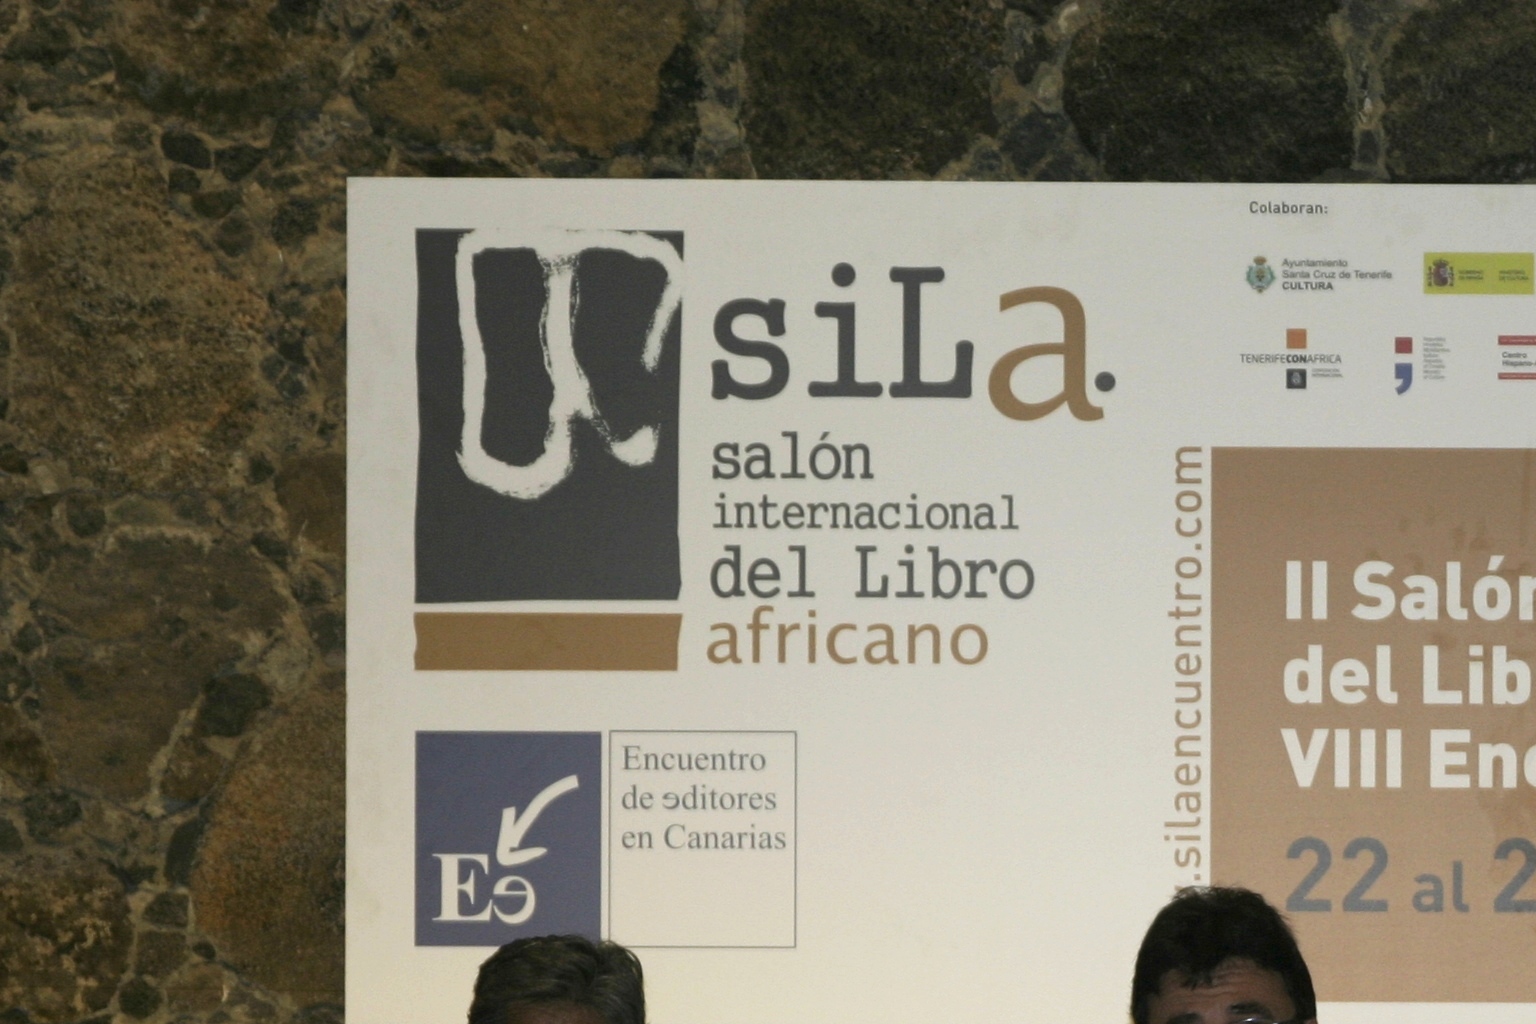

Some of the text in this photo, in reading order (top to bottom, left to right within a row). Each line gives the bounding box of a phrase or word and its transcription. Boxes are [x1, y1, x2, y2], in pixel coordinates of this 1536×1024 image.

[1249, 201, 1328, 215] Colaboran:
[1281, 258, 1348, 268] Ayuntamiento
[1281, 270, 1392, 279] Santa Cruz de Tenerife
[1281, 282, 1334, 290] CULTURA
[711, 432, 874, 480] salón
[712, 493, 1020, 530] internacional
[709, 545, 1036, 600] del Libro
[1285, 560, 1328, 621] II
[706, 605, 990, 666] africano
[1164, 445, 1203, 894] .silaencuentro.com
[1283, 644, 1398, 705] del
[622, 745, 766, 771] Encuentro
[1280, 728, 1402, 790] VIII
[621, 784, 654, 811] de
[621, 824, 787, 850] en Canarias
[1285, 836, 1390, 914] 22
[1411, 861, 1465, 915] al
